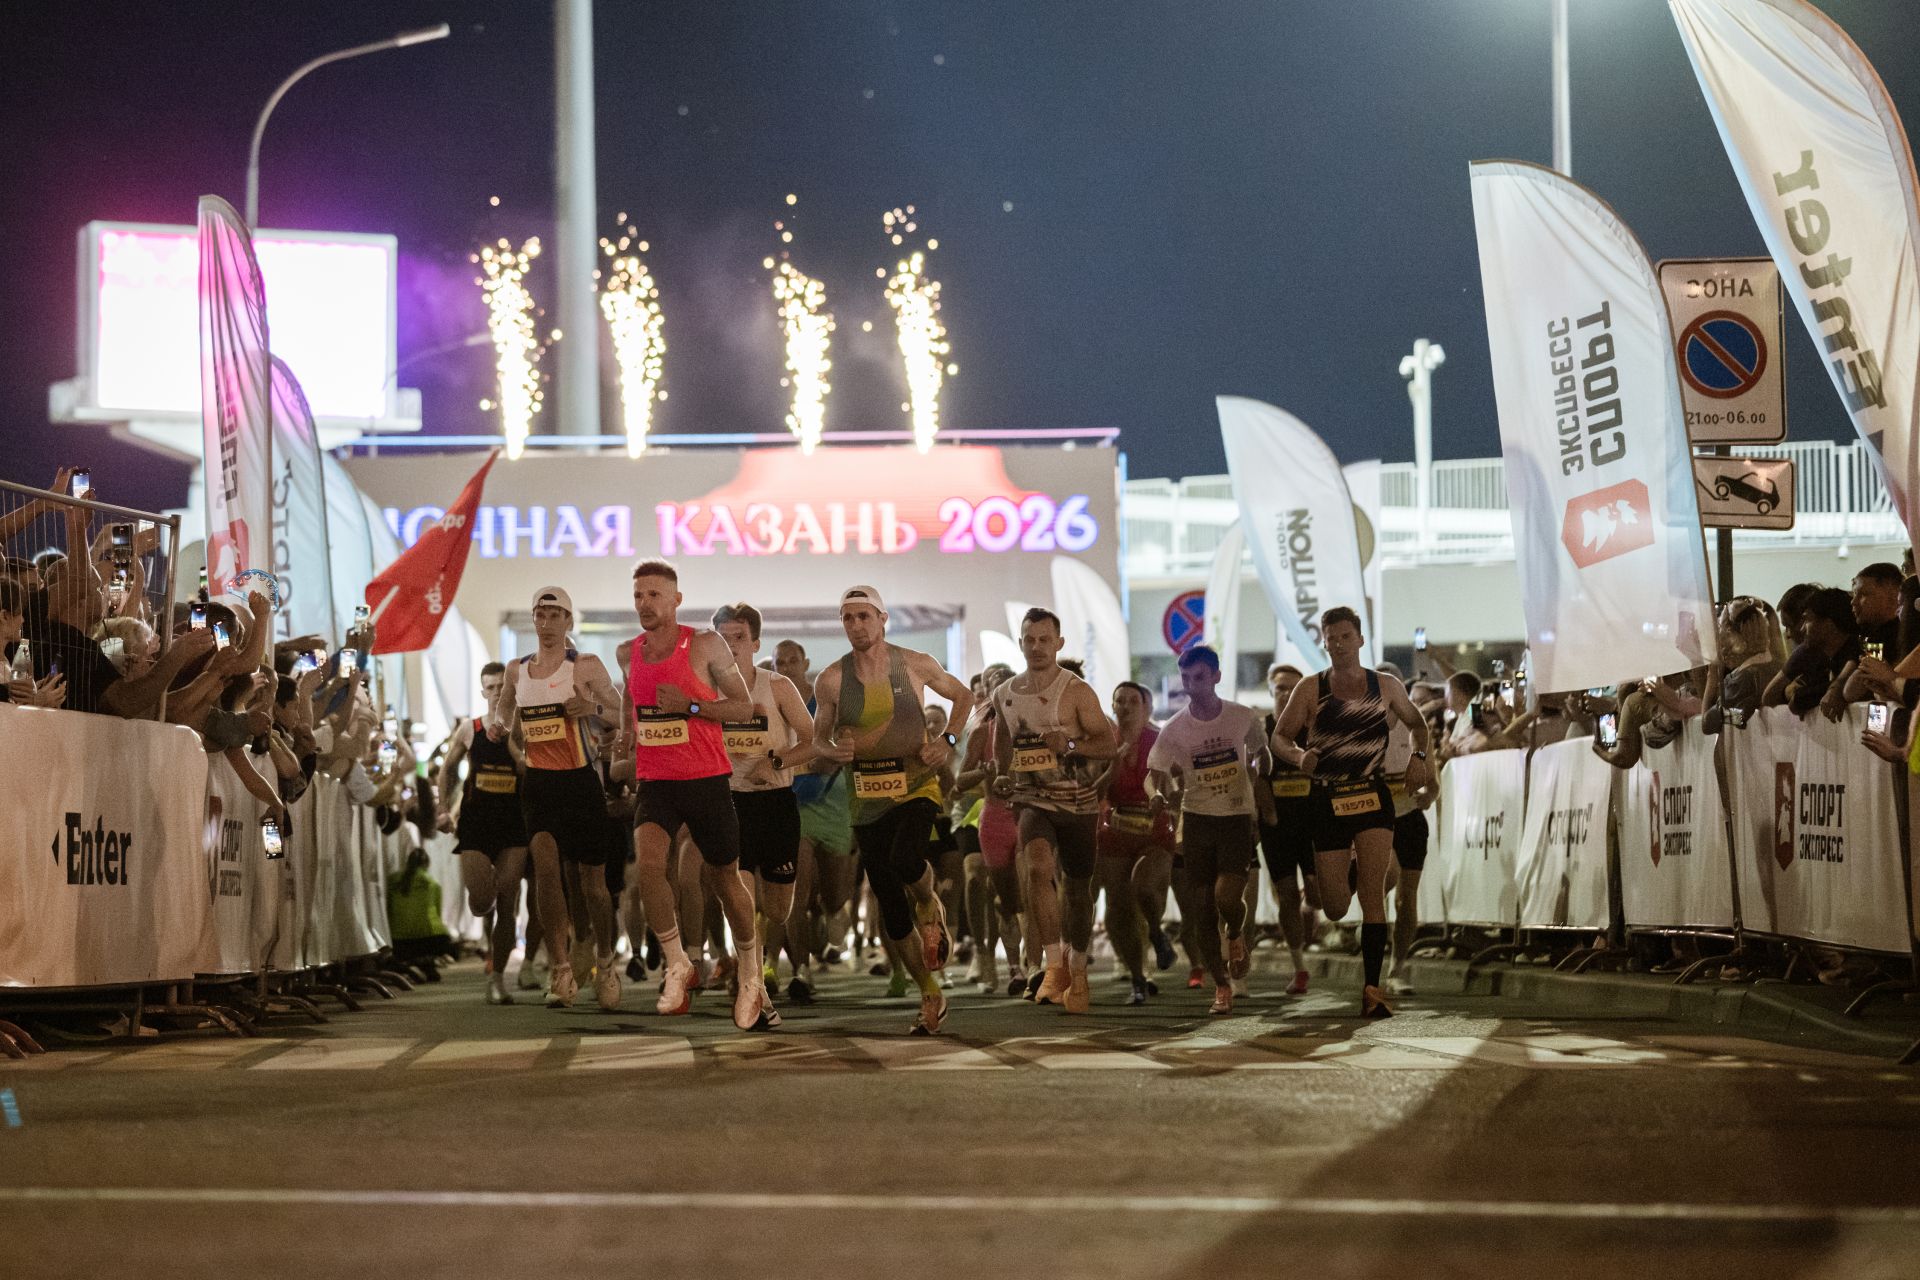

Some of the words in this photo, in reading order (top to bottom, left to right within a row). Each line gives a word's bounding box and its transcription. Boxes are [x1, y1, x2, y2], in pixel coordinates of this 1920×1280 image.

[656, 501, 918, 557] КАЗАНЬ
[938, 494, 1098, 554] 2026
[528, 724, 561, 737] 6937
[644, 726, 683, 740] 6428
[727, 736, 763, 748] 6434
[1020, 753, 1052, 766] 5001
[863, 779, 903, 792] 5002
[1663, 784, 1692, 826] СПОРТ
[1799, 783, 1845, 828] СПОРТ
[65, 812, 132, 886] Enter
[1799, 833, 1844, 863] ЭКСПРЕСС
